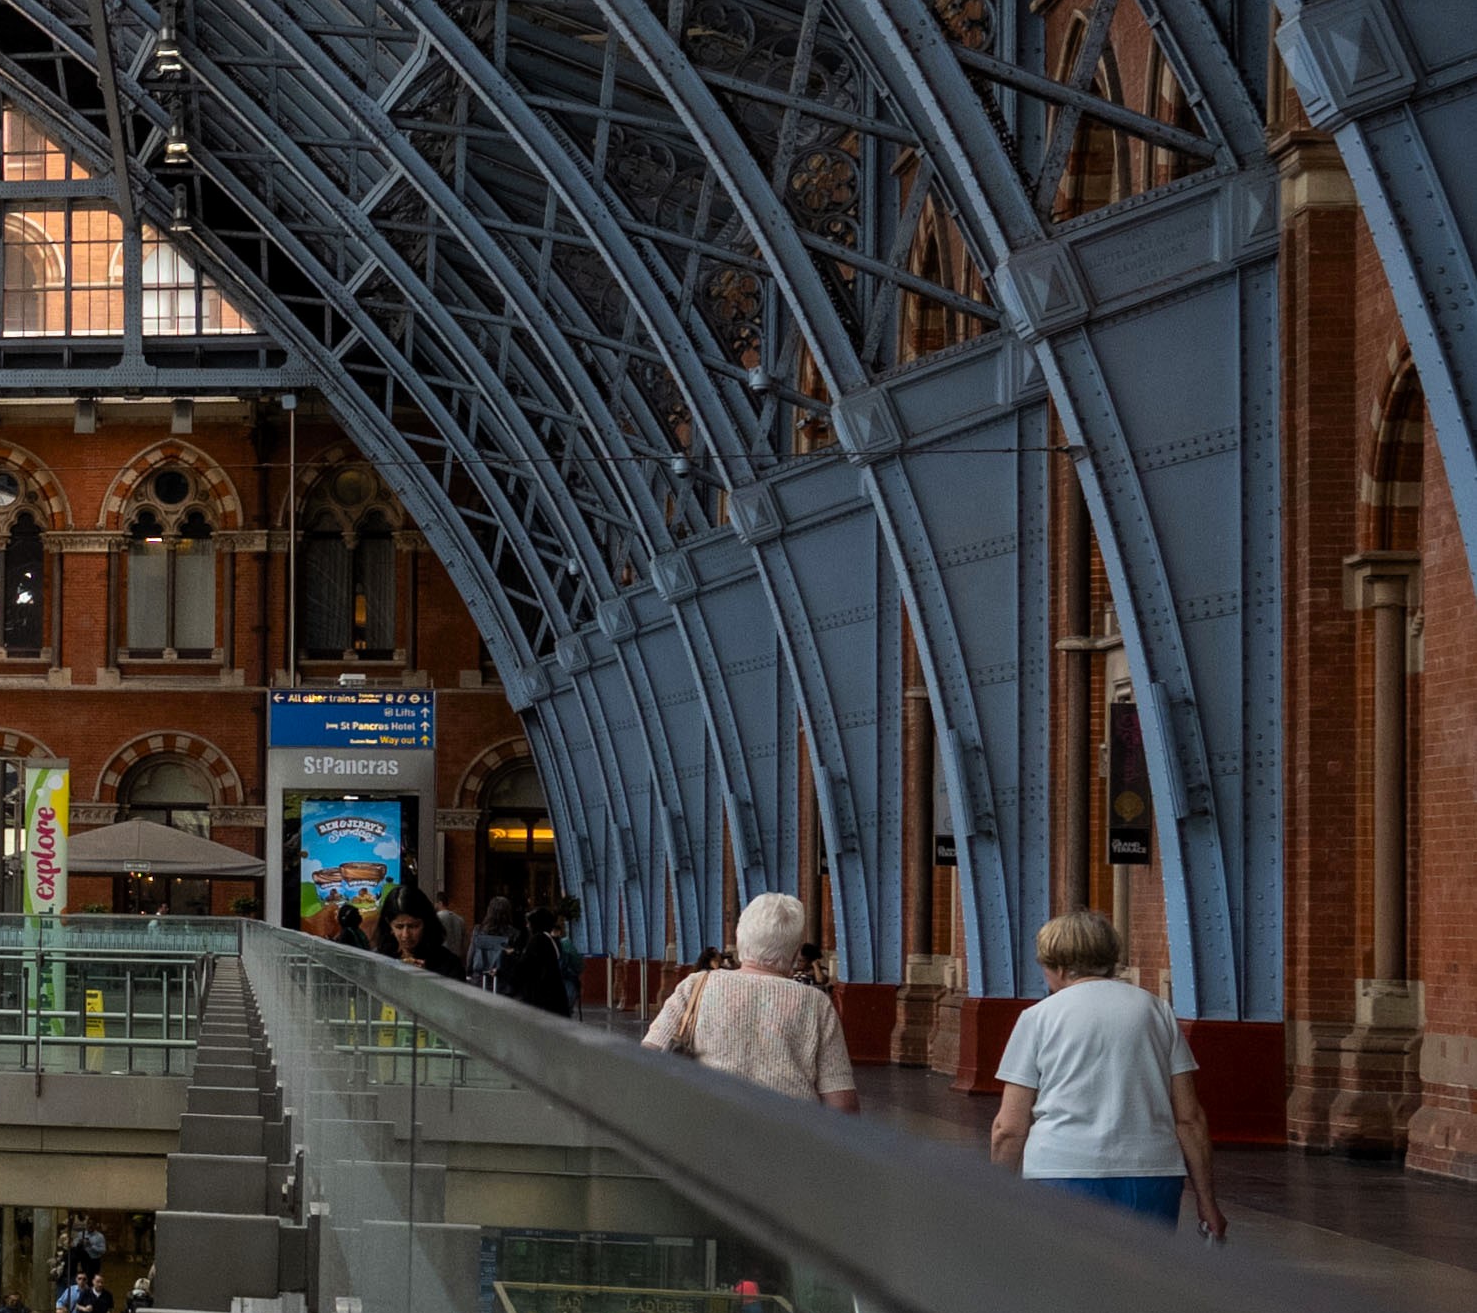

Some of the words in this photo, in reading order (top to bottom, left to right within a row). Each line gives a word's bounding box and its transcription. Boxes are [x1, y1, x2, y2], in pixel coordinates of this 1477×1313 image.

[287, 694, 301, 703] All
[302, 694, 327, 703] other
[328, 694, 356, 703] trains
[395, 708, 416, 717] Lifts
[340, 722, 351, 731] St
[352, 722, 389, 731] Pancras
[391, 722, 416, 731] Hotel
[379, 736, 398, 746] Way
[400, 736, 416, 745] out
[31, 806, 56, 900] explore
